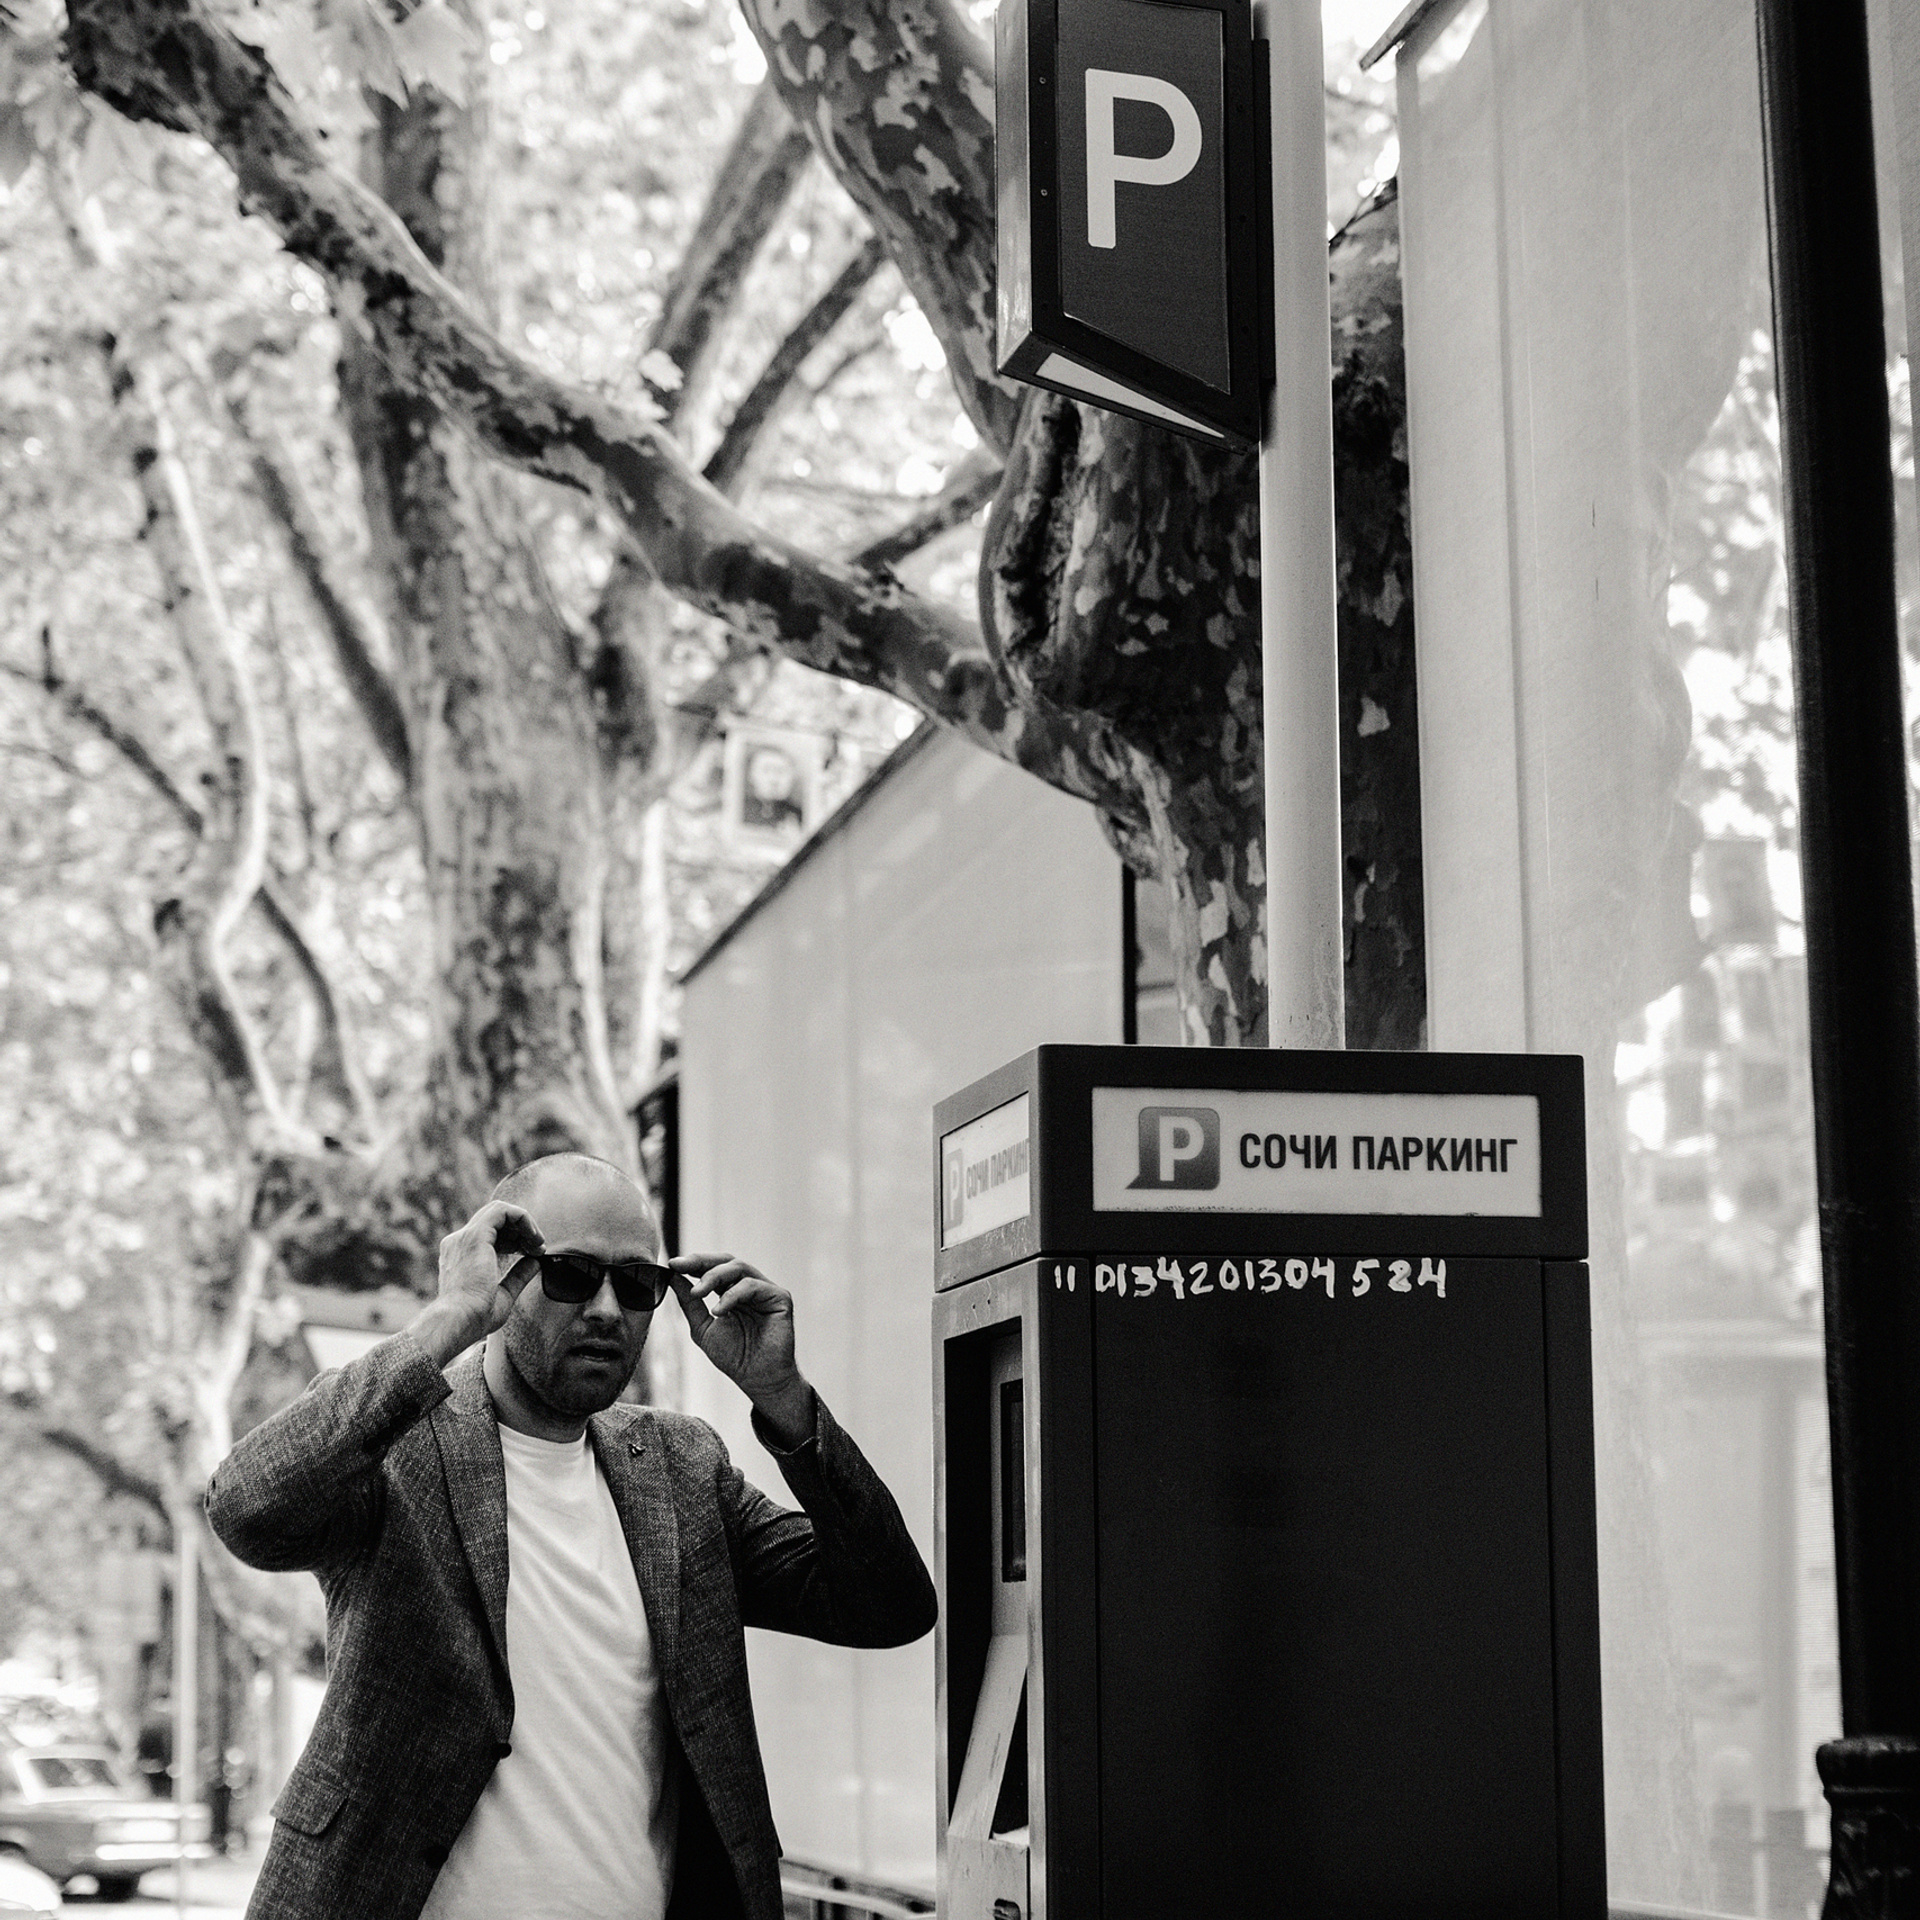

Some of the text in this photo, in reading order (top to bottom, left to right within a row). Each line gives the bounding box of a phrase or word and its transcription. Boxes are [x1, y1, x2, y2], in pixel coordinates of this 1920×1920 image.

[1085, 68, 1203, 250] P
[1239, 1132, 1338, 1170] СОЧИ
[1352, 1135, 1519, 1173] ПАРКИНГ
